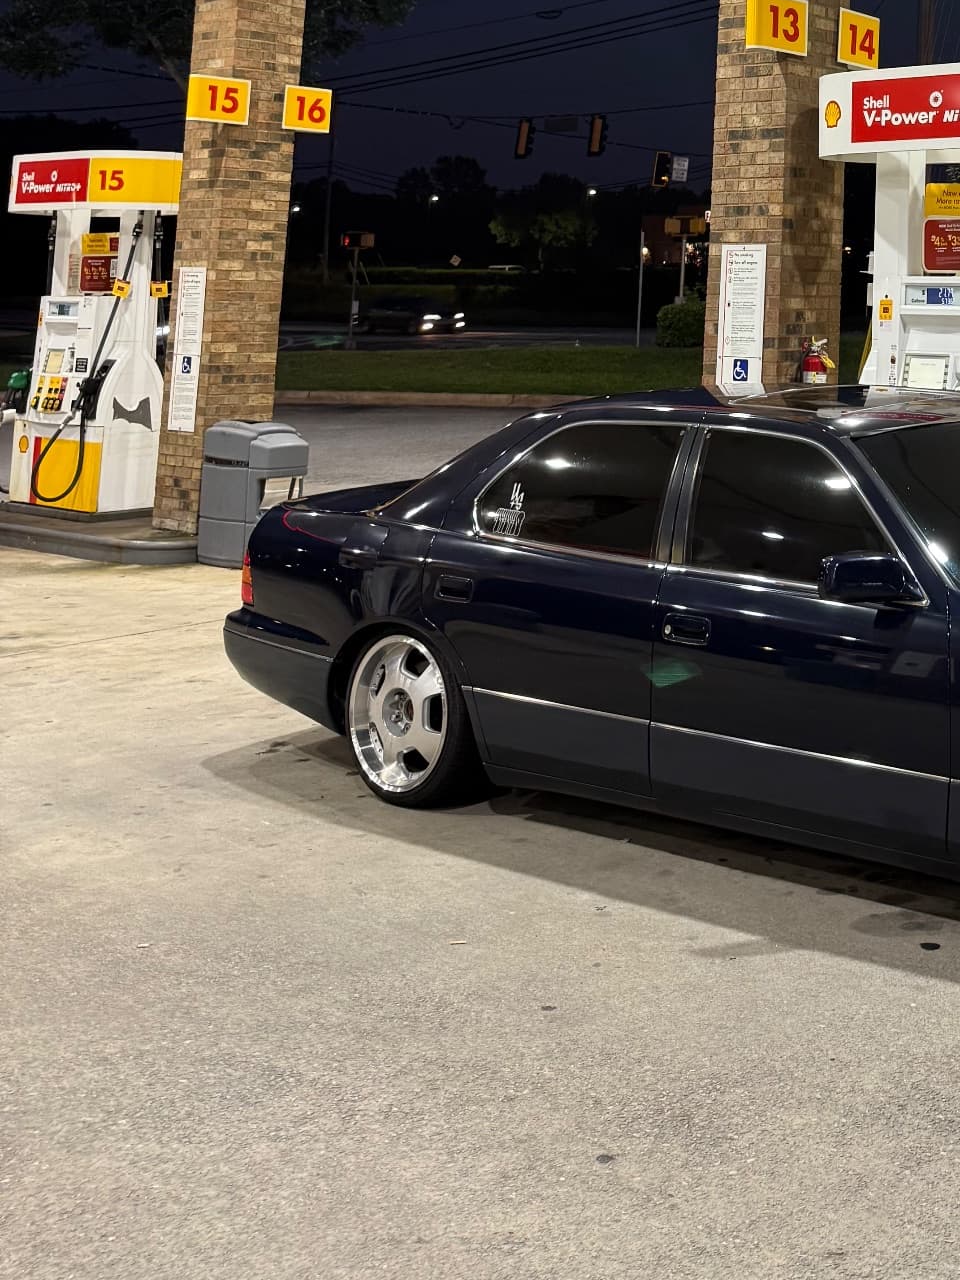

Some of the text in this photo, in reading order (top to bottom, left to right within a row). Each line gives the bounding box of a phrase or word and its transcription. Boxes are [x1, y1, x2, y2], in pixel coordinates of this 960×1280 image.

[769, 4, 800, 42] 13
[849, 23, 876, 60] 14
[207, 85, 240, 115] 15
[296, 97, 327, 124] 16
[863, 95, 890, 109] Shell
[863, 109, 937, 127] V-Power
[22, 172, 35, 182] Shell
[22, 181, 54, 194] V-Power
[98, 169, 125, 192] 15
